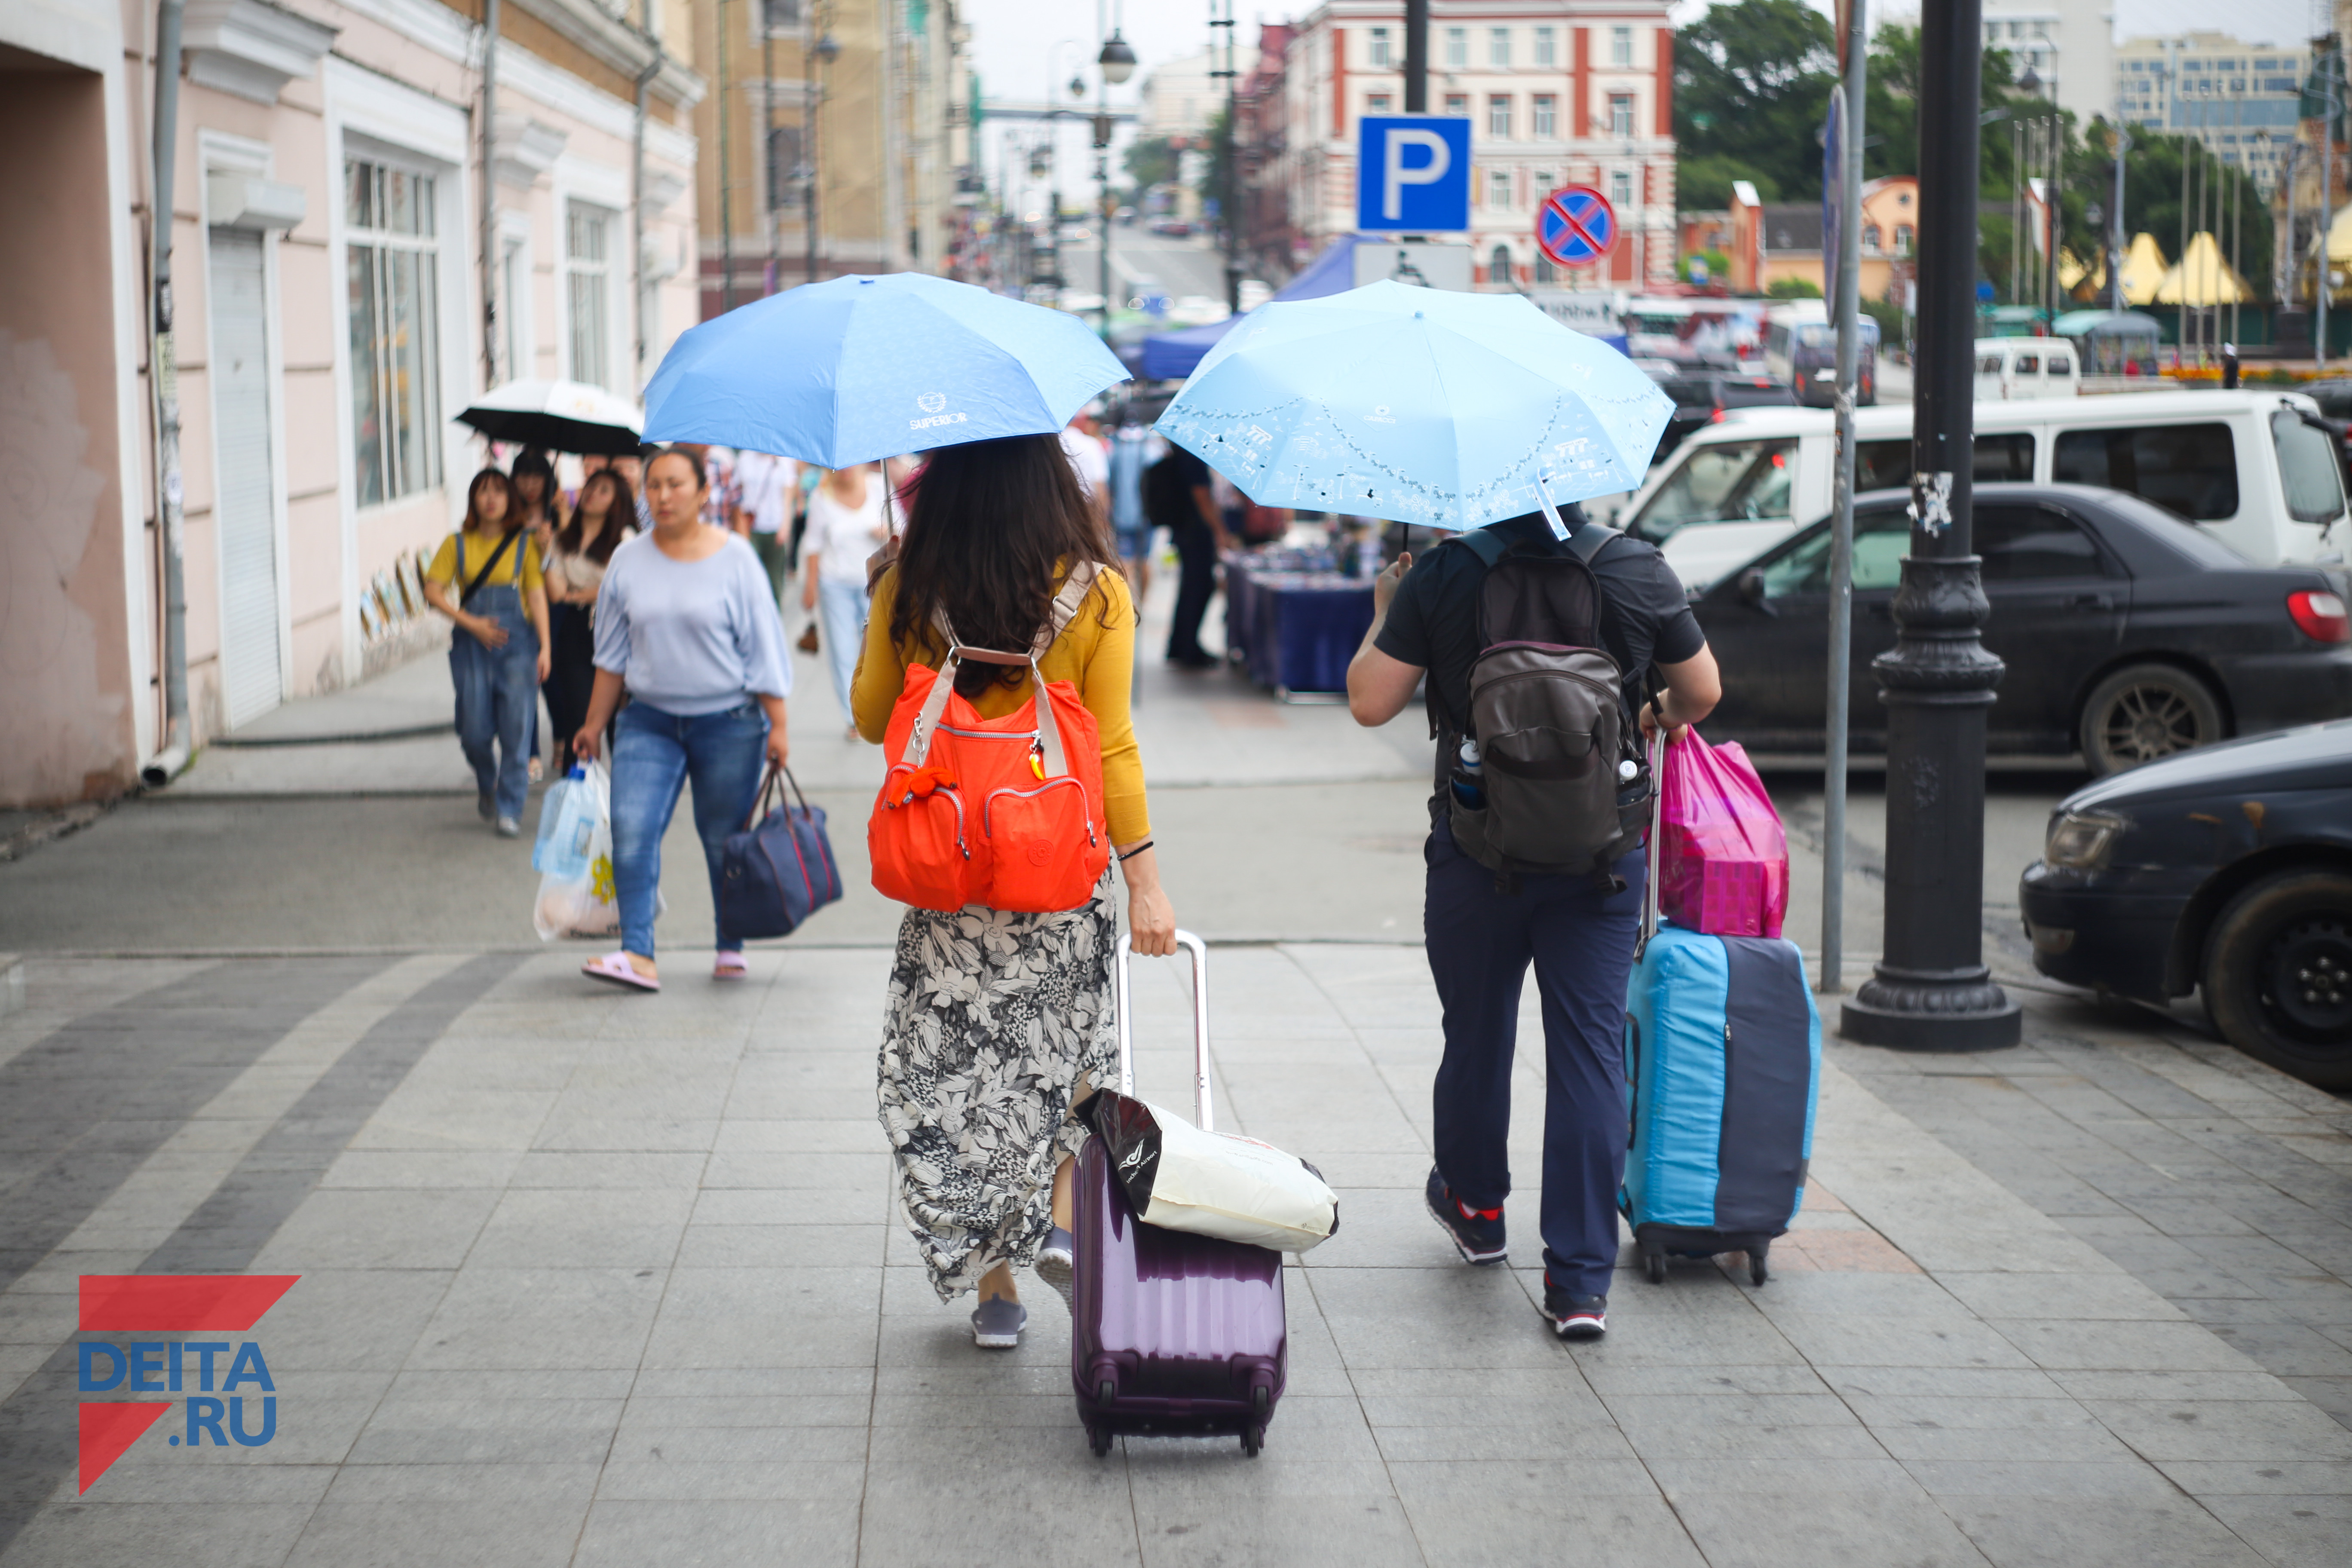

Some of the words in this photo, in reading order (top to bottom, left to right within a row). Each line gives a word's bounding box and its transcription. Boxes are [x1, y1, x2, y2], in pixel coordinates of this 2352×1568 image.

[1383, 128, 1452, 220] P
[909, 412, 967, 430] SUPERIOR
[1140, 1151, 1158, 1167] Airport
